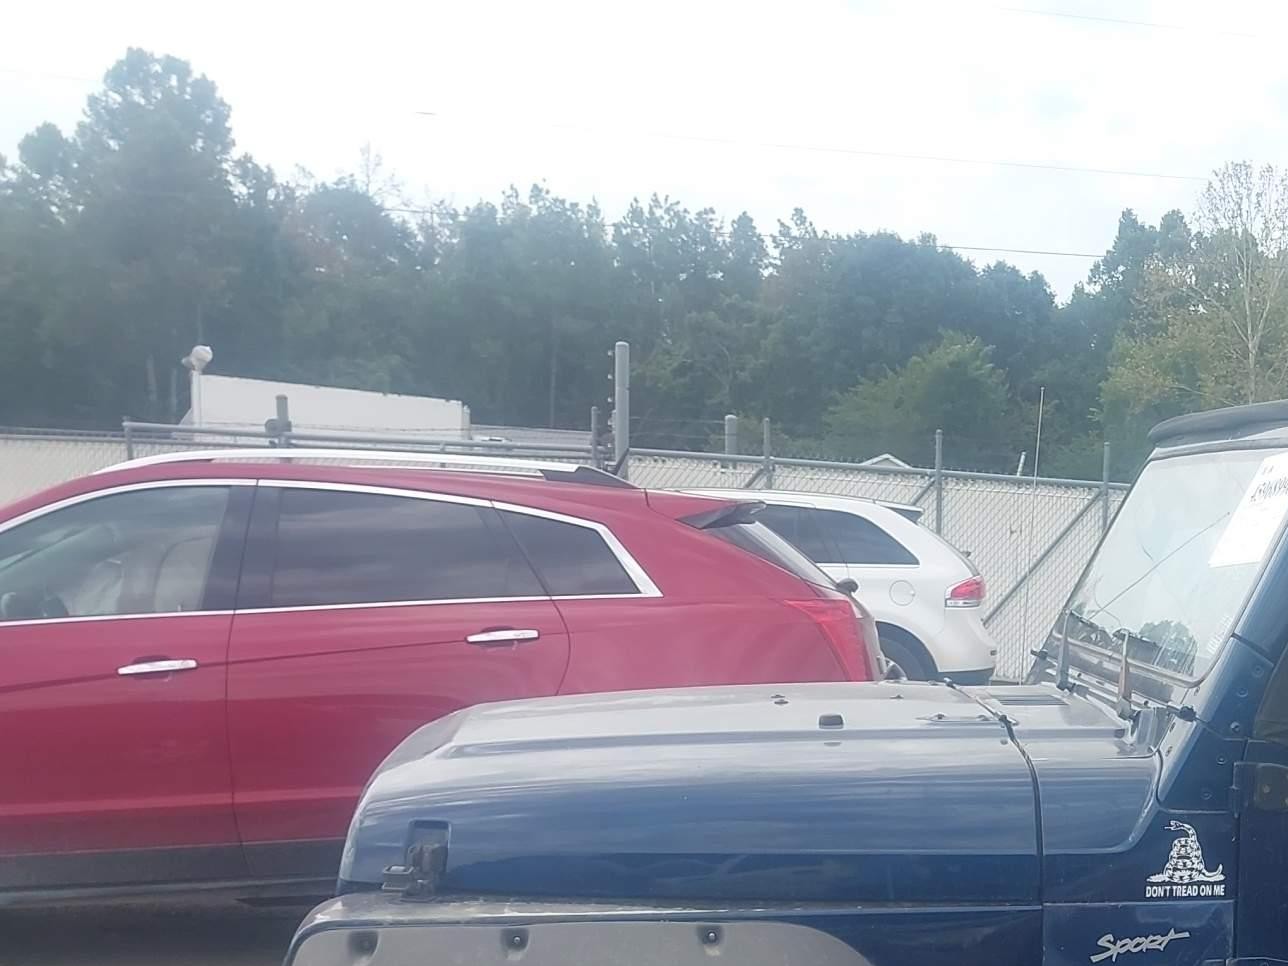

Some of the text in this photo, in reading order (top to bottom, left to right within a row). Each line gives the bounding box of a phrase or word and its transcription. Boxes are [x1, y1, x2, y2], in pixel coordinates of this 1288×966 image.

[1145, 884, 1226, 898] DON'T TREAD ON ME
